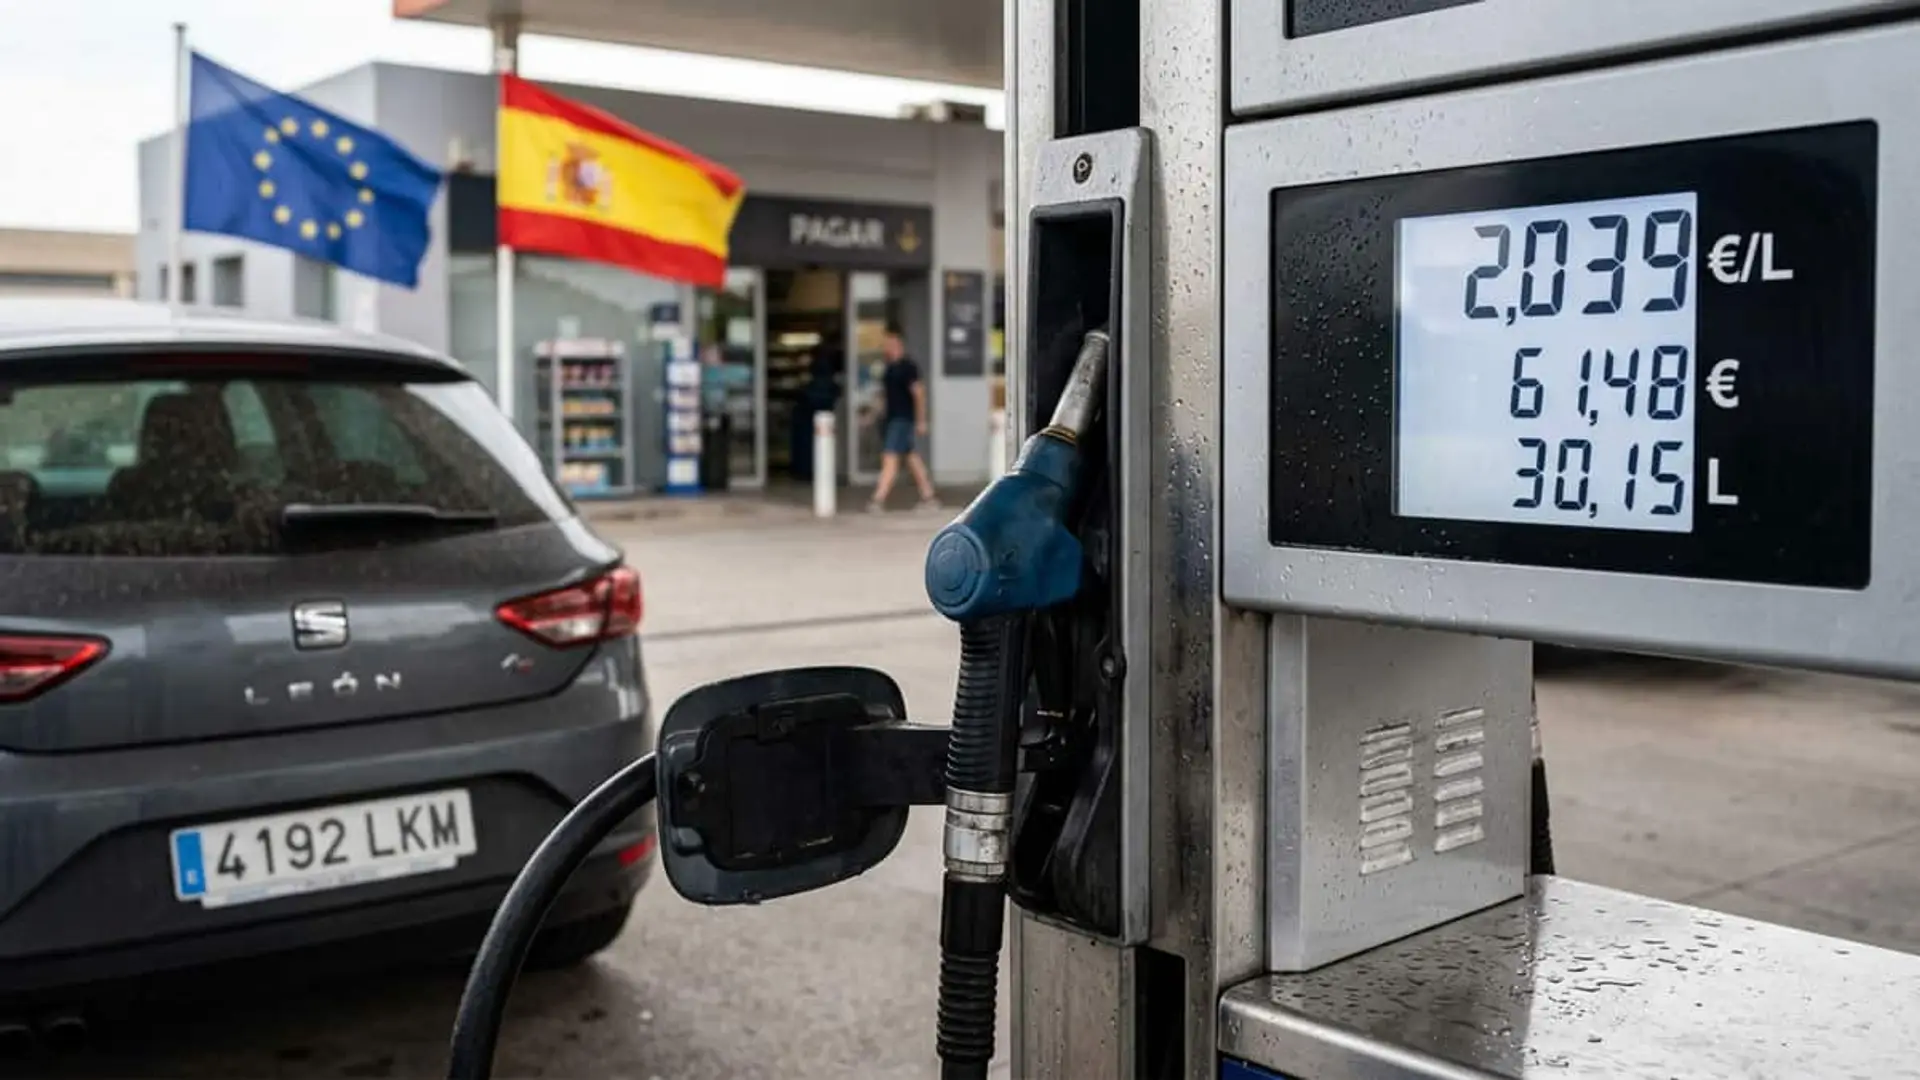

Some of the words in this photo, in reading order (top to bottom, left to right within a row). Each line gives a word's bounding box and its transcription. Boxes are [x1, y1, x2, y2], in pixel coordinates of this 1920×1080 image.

[789, 213, 885, 248] PAGAR
[1464, 209, 1691, 326] 2,039
[1707, 232, 1793, 284] €/L
[1510, 345, 1688, 426] 61,48
[1706, 358, 1740, 408] €
[1512, 438, 1685, 518] 30,15
[1707, 458, 1739, 504] L
[216, 817, 348, 880] 4192
[364, 801, 460, 858] LKM
